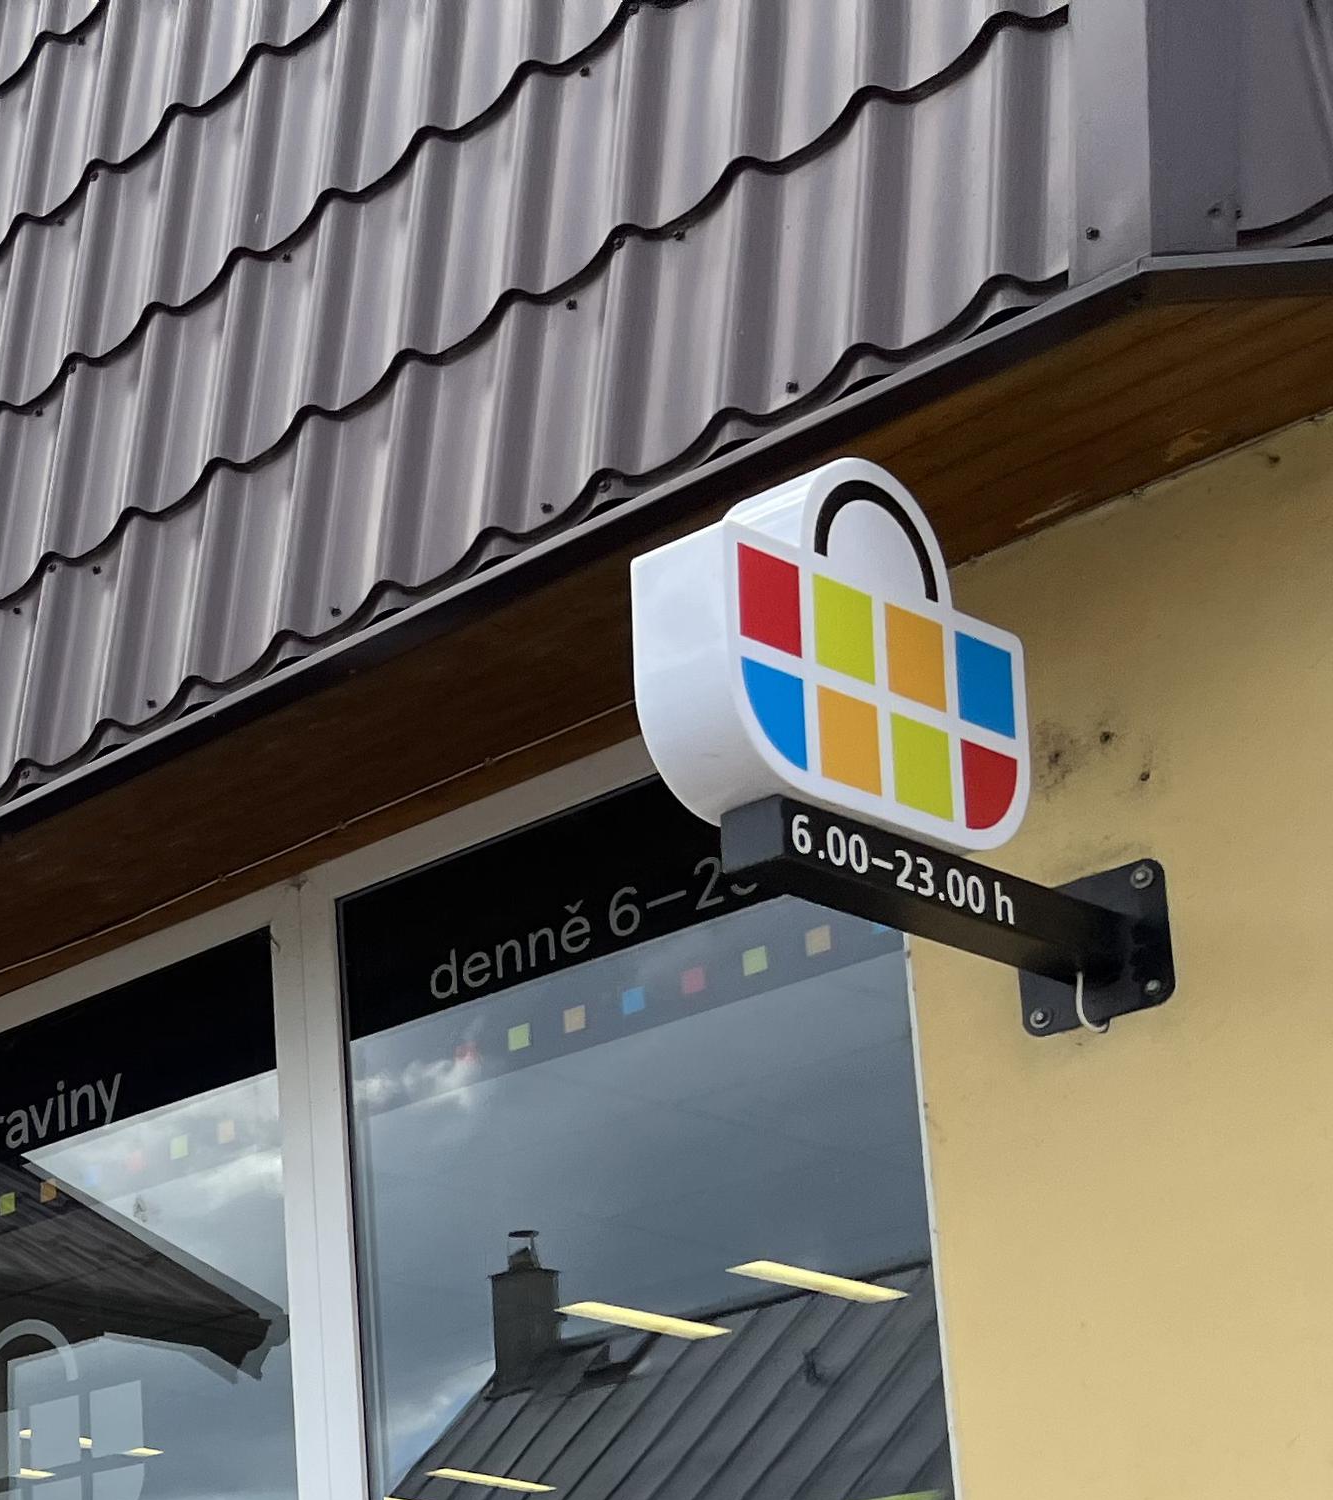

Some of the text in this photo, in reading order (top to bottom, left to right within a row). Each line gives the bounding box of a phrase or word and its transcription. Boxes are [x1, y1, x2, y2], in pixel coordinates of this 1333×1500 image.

[791, 814, 1016, 926] 6.00–23.00 h
[430, 900, 591, 999] denně
